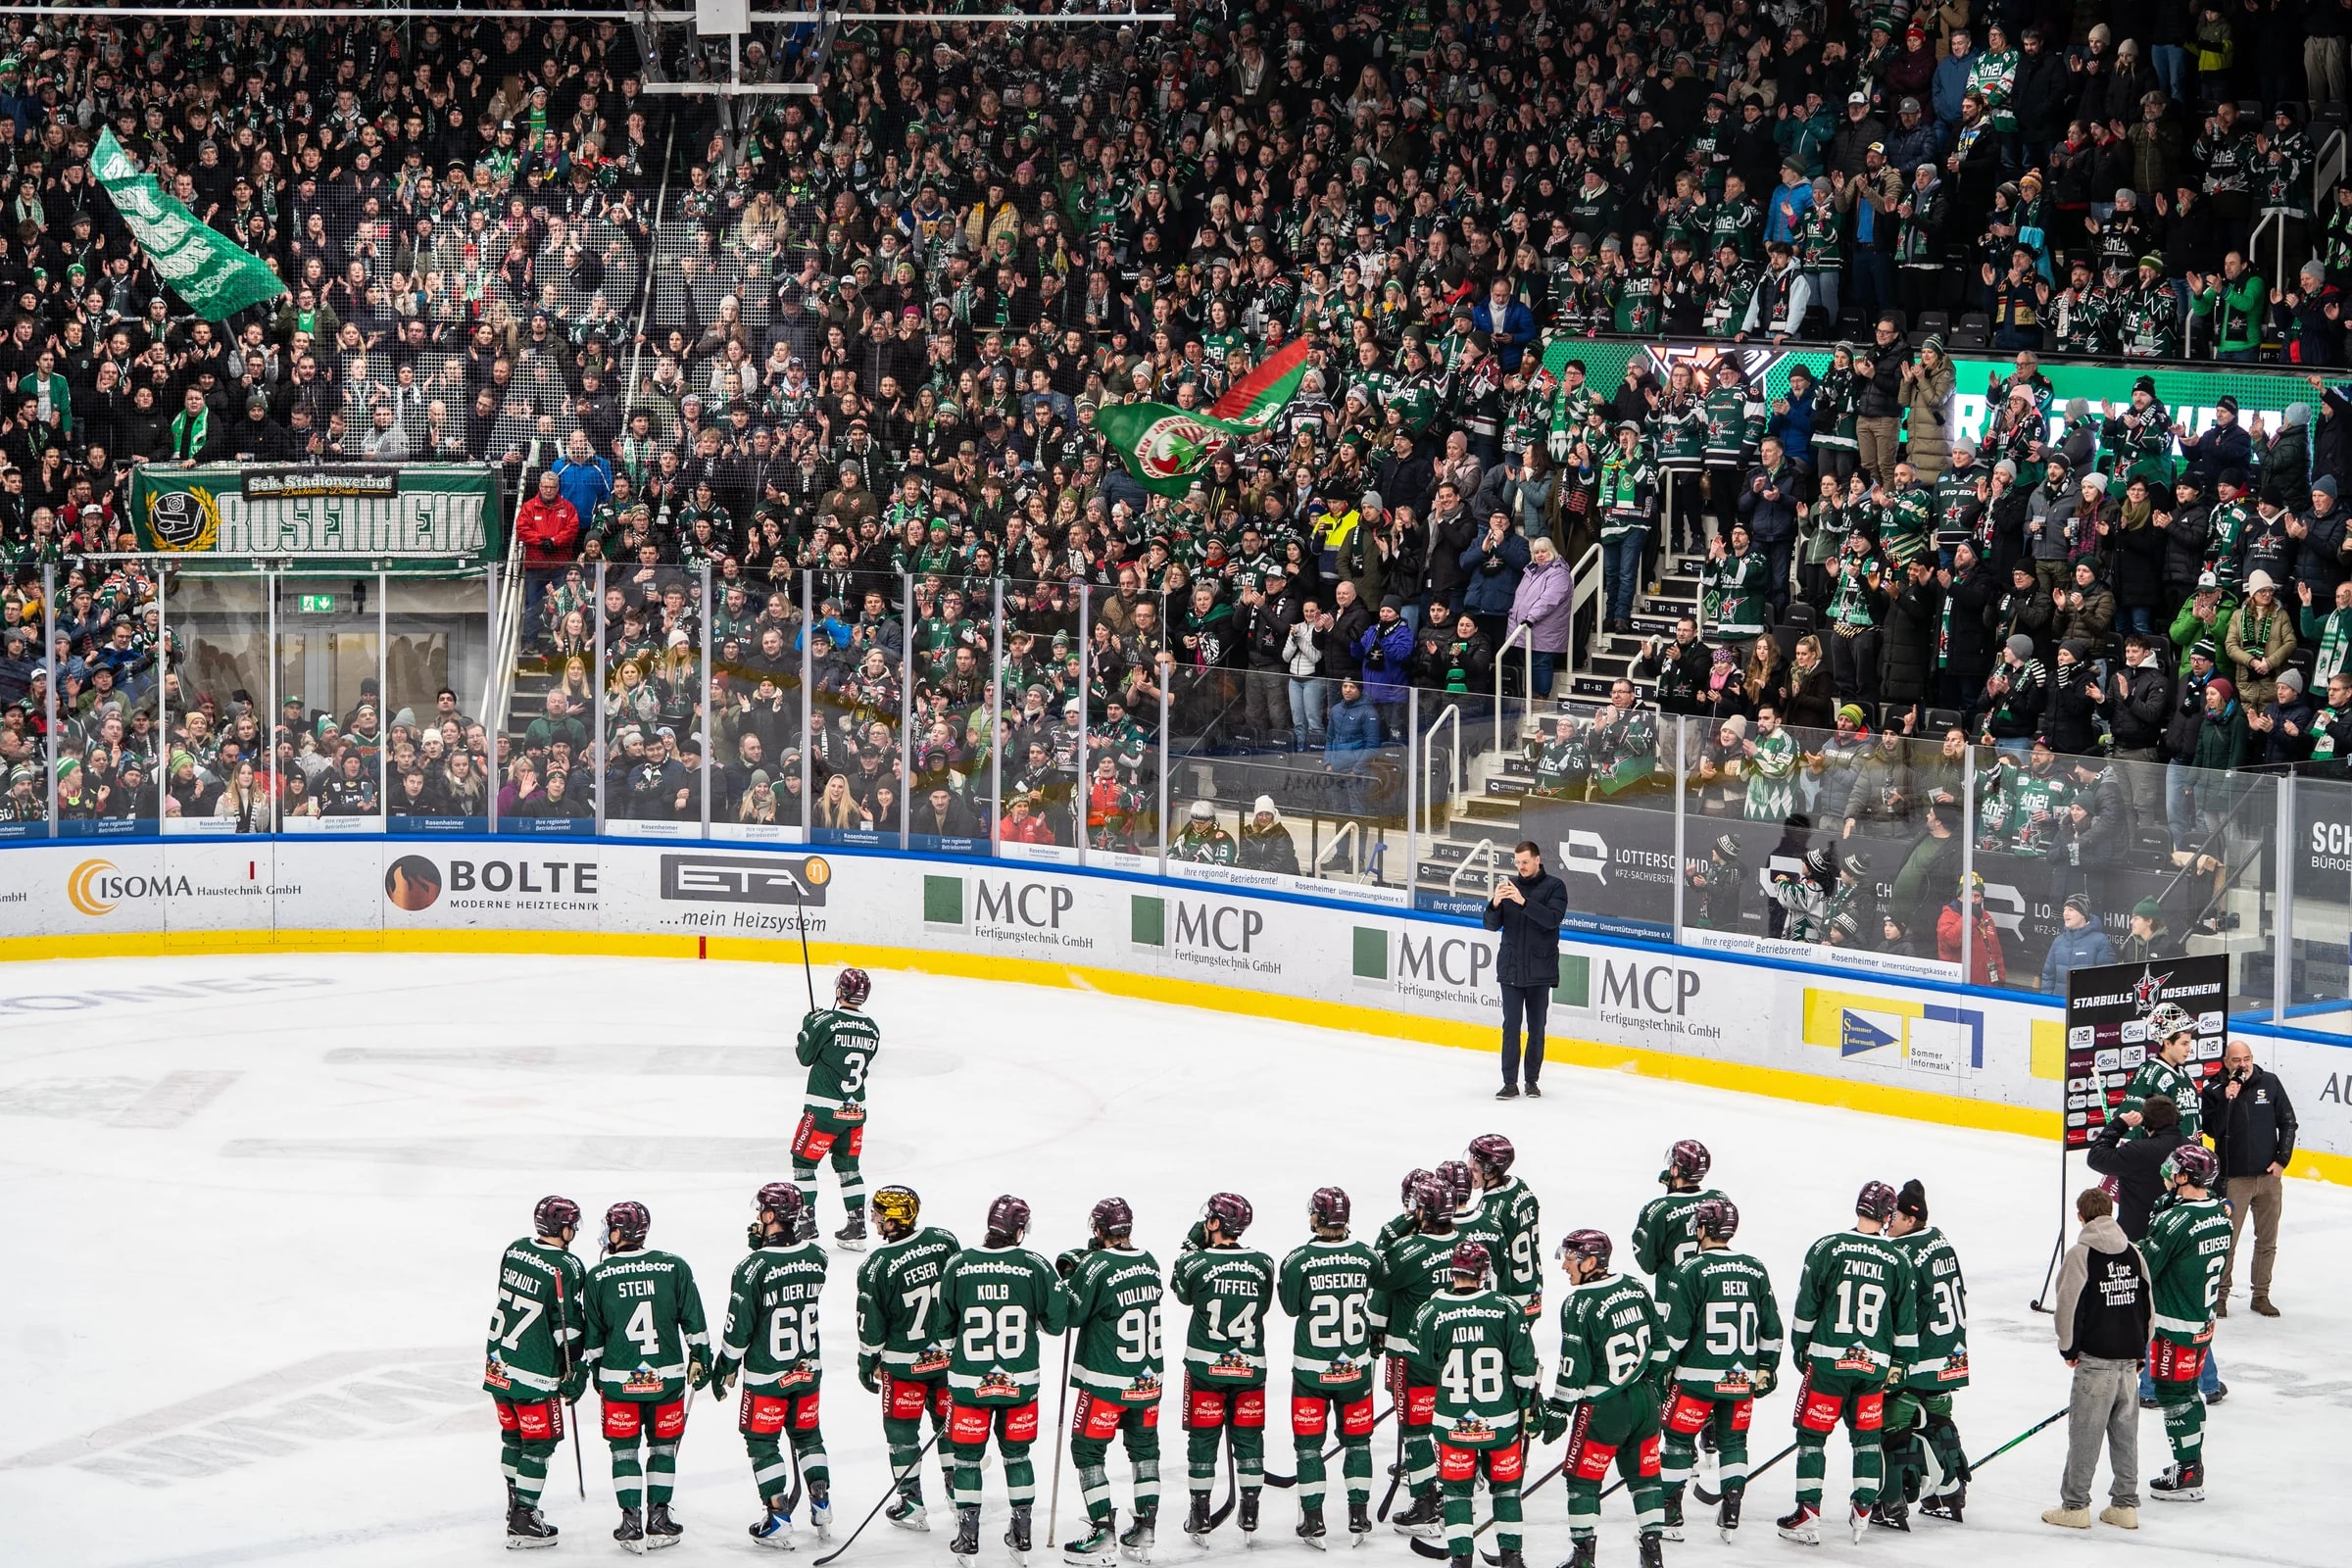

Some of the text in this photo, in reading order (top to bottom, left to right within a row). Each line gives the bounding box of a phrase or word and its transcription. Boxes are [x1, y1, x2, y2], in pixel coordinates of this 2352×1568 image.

[219, 491, 486, 553] ROSENHEIM
[1616, 848, 1708, 872] LOTTERSCMID
[101, 875, 303, 900] ISOMA Haustechnik GmbH
[449, 859, 599, 895] BOLTE
[677, 864, 810, 897] ETA
[1184, 867, 1198, 877] Ihre
[1199, 868, 1230, 880] regionale
[1230, 873, 1279, 886] Betriebsrente!
[1295, 881, 1337, 895] Rosenheimer
[1339, 888, 1396, 904] Unterstützungskasse
[450, 900, 600, 911] MODERNE HEIZTECHNIK
[975, 879, 1074, 930] MCP
[1433, 900, 1483, 913] Ihre regionale
[732, 910, 827, 933] Heizsystem
[1175, 900, 1264, 954] MCP
[1560, 917, 1598, 930] senheimer
[1599, 922, 1661, 938] Unterstützungskasse
[975, 925, 1094, 949] Fertigungstechnik GmbH
[1175, 949, 1282, 975] Fertigungstechnik GmbH
[1397, 932, 1494, 988] MCP
[1702, 936, 1960, 978] Ihre regionale Betriebsrente! Rosenheimer Unterstützungskasse e.V.
[1397, 981, 1502, 1009] Fertigungstechnik Gmb
[1600, 958, 1701, 1016] MCP
[2073, 982, 2222, 1009] STARBULLS ROSENHEIM
[1600, 1010, 1721, 1039] Fertigungstechnik GmbH
[1843, 1017, 1873, 1034] Sommer
[2128, 1029, 2144, 1038] ROFA
[834, 1034, 877, 1052] PULKKINEN
[1911, 1048, 1942, 1059] Sommer
[840, 1052, 866, 1094] 3
[1910, 1057, 1950, 1071] Informatik
[2101, 1057, 2118, 1066] ROFA
[795, 1111, 815, 1152] vitagroup
[1422, 1247, 1454, 1269] schatt
[1832, 1242, 1898, 1267] schattdecor
[503, 1267, 542, 1296] SARAULT
[595, 1259, 675, 1282] schattdecor
[903, 1261, 938, 1287] FESER
[956, 1260, 1033, 1278] schattdecor
[1308, 1272, 1368, 1291] BOSECKER
[1700, 1261, 1764, 1279] schattdecor
[1843, 1259, 1885, 1281] ZWICKL
[2107, 1260, 2132, 1278] Live
[2204, 1255, 2227, 1309] 2
[618, 1279, 656, 1299] STEIN
[782, 1285, 804, 1302] DER
[977, 1284, 1009, 1300] KOLB
[1213, 1278, 1259, 1297] TIFFELS
[1722, 1280, 1748, 1297] BECK
[2099, 1276, 2140, 1294] without
[1596, 1287, 1644, 1321] schattdeco
[1835, 1280, 1886, 1338] 18
[2105, 1291, 2136, 1307] limits
[624, 1300, 661, 1355] 4
[1205, 1298, 1258, 1348] 14
[1308, 1293, 1367, 1348] 26
[1433, 1306, 1506, 1330] schattdecor
[1611, 1304, 1643, 1330] HANNA
[1705, 1301, 1759, 1356] 50
[962, 1304, 1028, 1362] 28
[1115, 1305, 1162, 1363] 98
[1451, 1325, 1484, 1344] ADAM
[2160, 1339, 2172, 1378] vitagro
[1441, 1348, 1504, 1403] 48
[1396, 1363, 1405, 1422] vitagroup
[1662, 1384, 1678, 1421] vitagro
[552, 1397, 563, 1435] vitagr
[1073, 1389, 1090, 1430] vitagr
[1566, 1411, 1589, 1471] vitagroup
